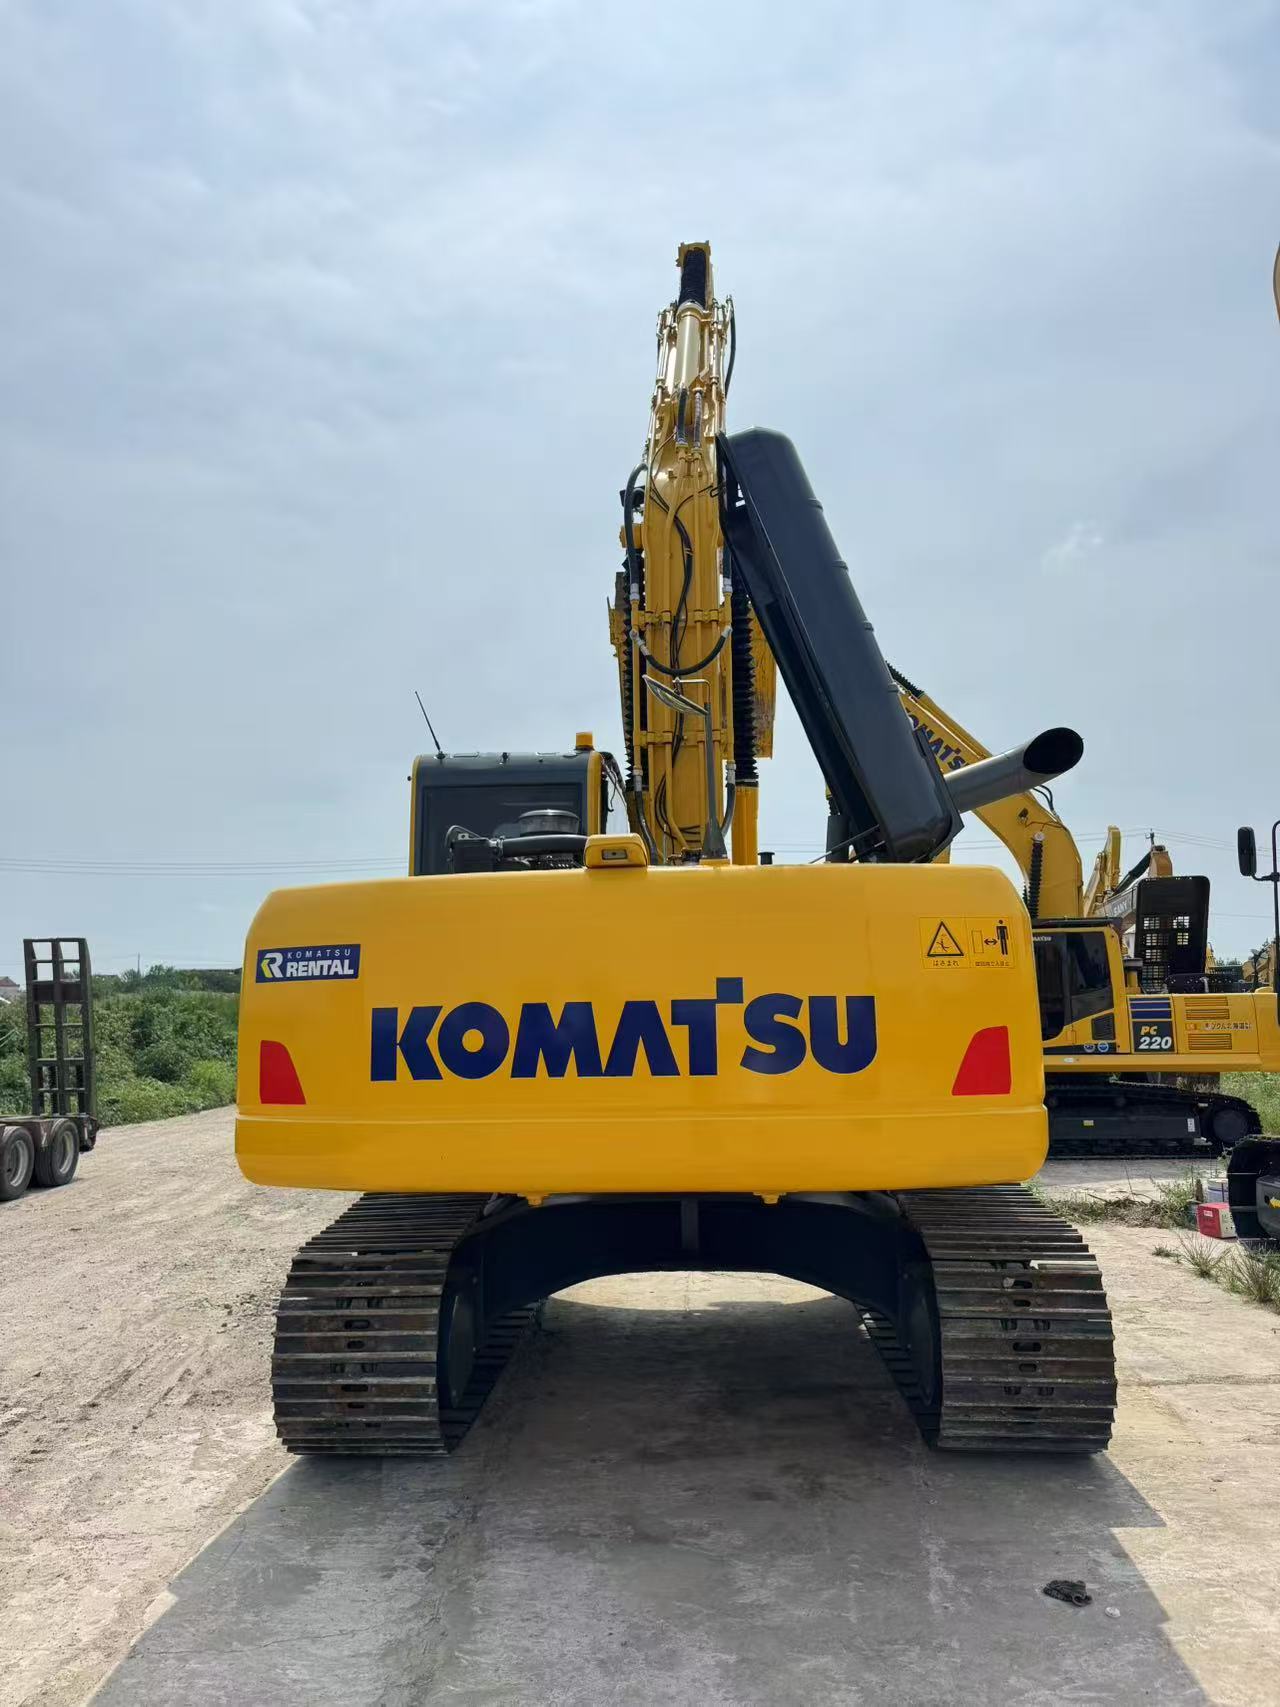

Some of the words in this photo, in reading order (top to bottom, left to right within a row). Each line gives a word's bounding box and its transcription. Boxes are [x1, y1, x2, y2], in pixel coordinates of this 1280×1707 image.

[287, 949, 351, 959] KOMATSU
[286, 959, 354, 977] RENTAL
[371, 977, 878, 1082] KOMATSU
[1140, 1025, 1158, 1036] PC
[1138, 1036, 1172, 1049] 220
